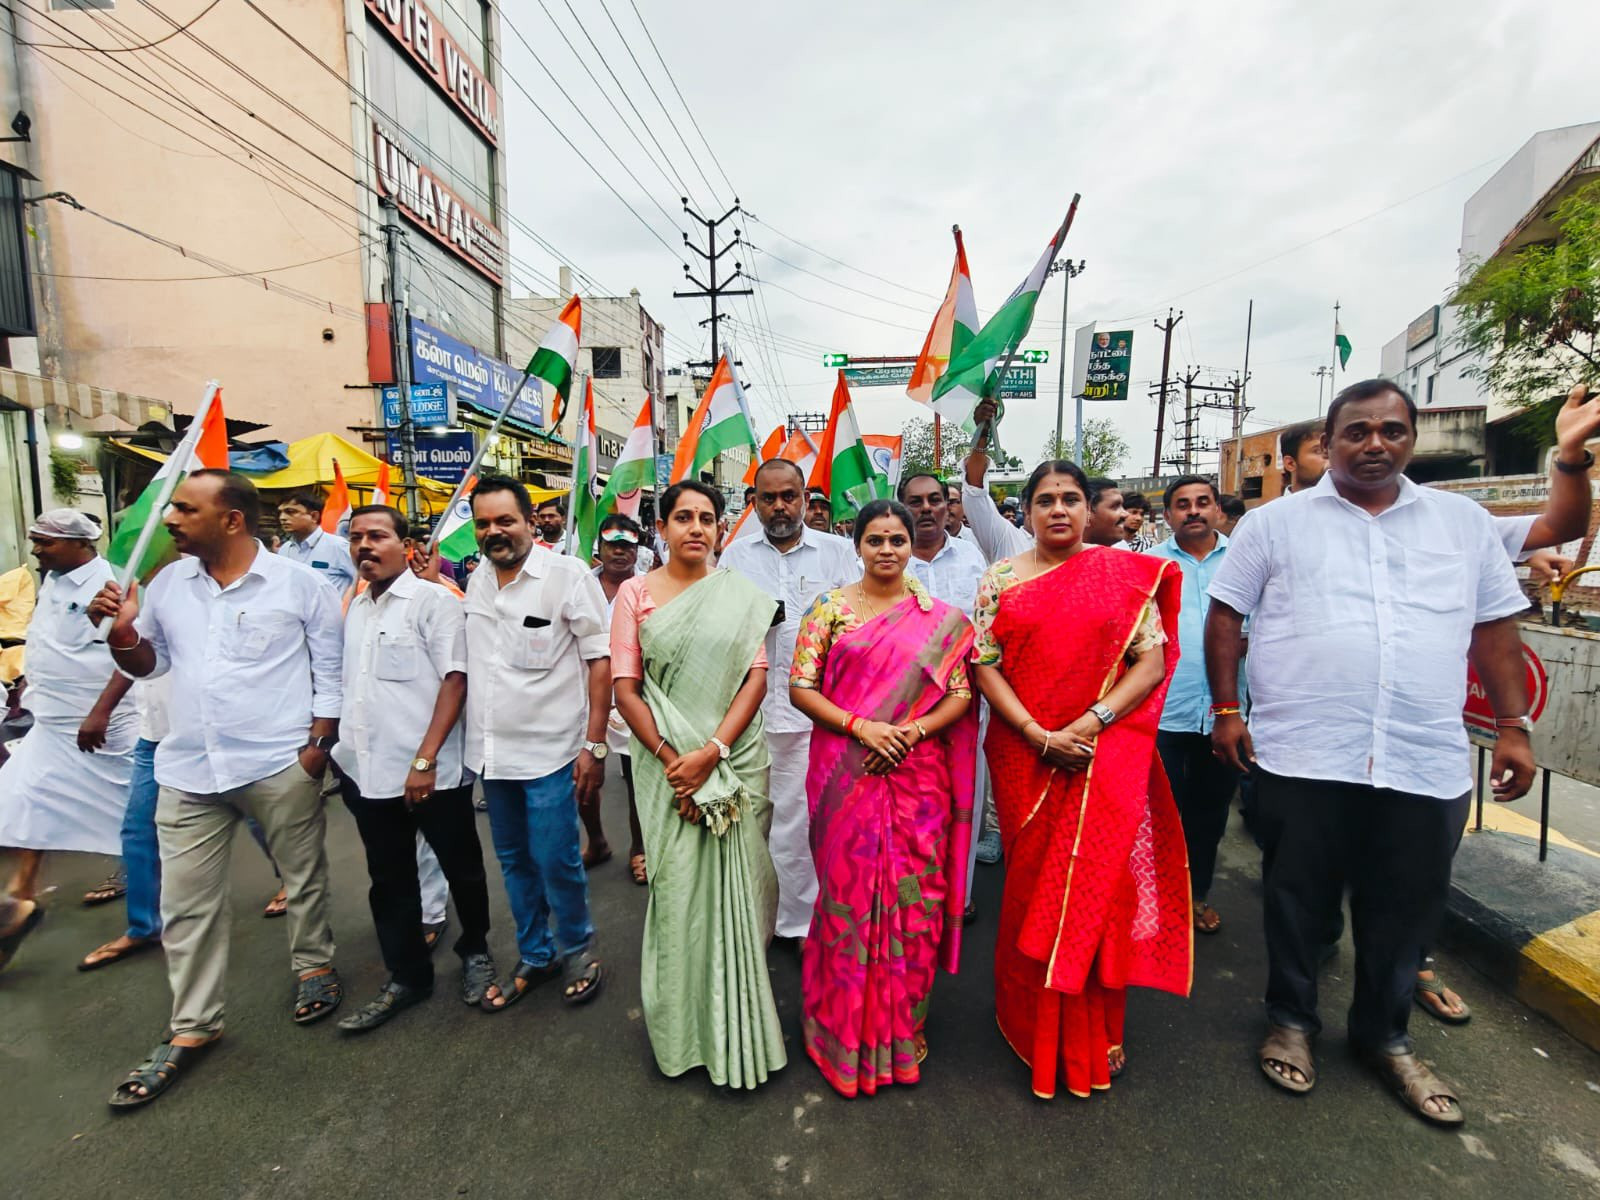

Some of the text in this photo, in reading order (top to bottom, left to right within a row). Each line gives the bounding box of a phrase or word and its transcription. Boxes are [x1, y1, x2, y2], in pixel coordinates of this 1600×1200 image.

[416, 338, 452, 370] கலா
[454, 354, 489, 386] மெஸ்
[430, 446, 472, 463] மெஸ்
